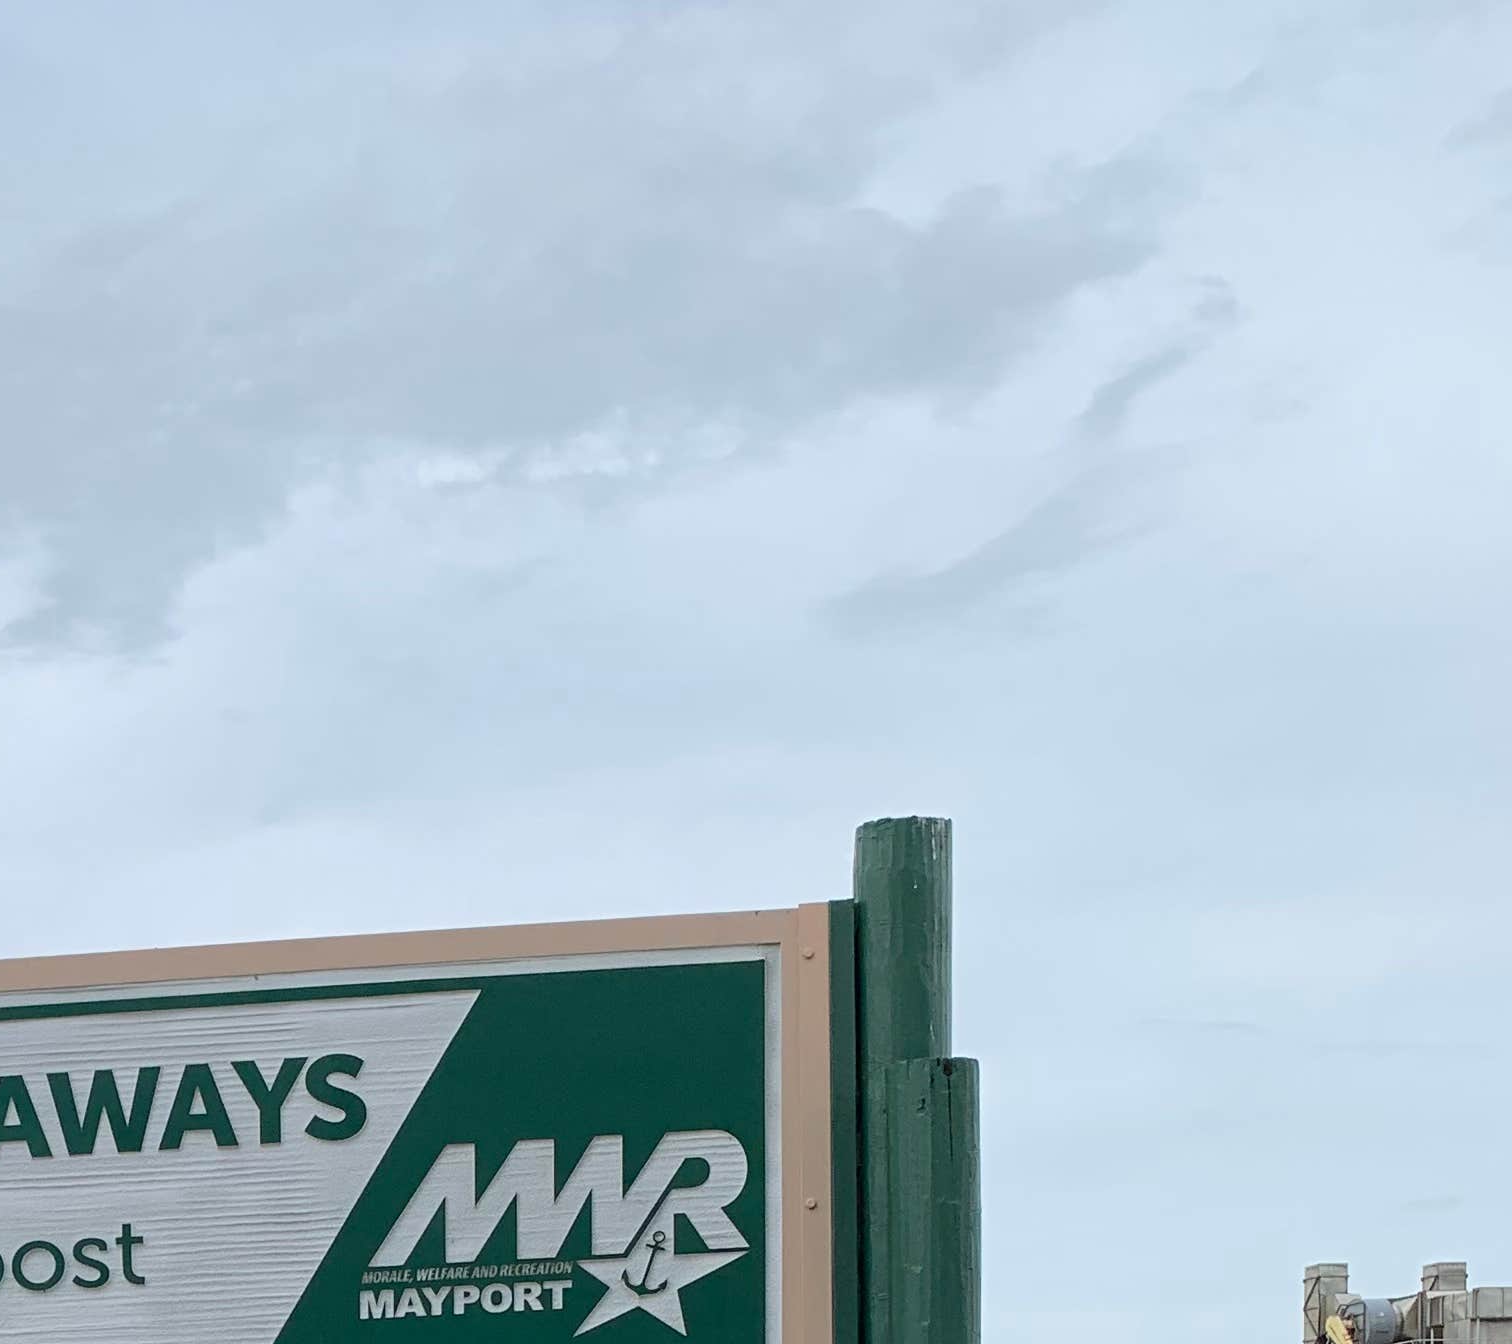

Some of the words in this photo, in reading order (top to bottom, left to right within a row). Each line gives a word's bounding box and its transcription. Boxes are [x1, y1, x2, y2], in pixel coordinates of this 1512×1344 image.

[361, 1269, 414, 1285] MORALE,
[416, 1265, 470, 1282] WELFARE
[470, 1264, 498, 1279] AND
[499, 1260, 574, 1277] RECREATION
[359, 1279, 573, 1320] MAYPORT
